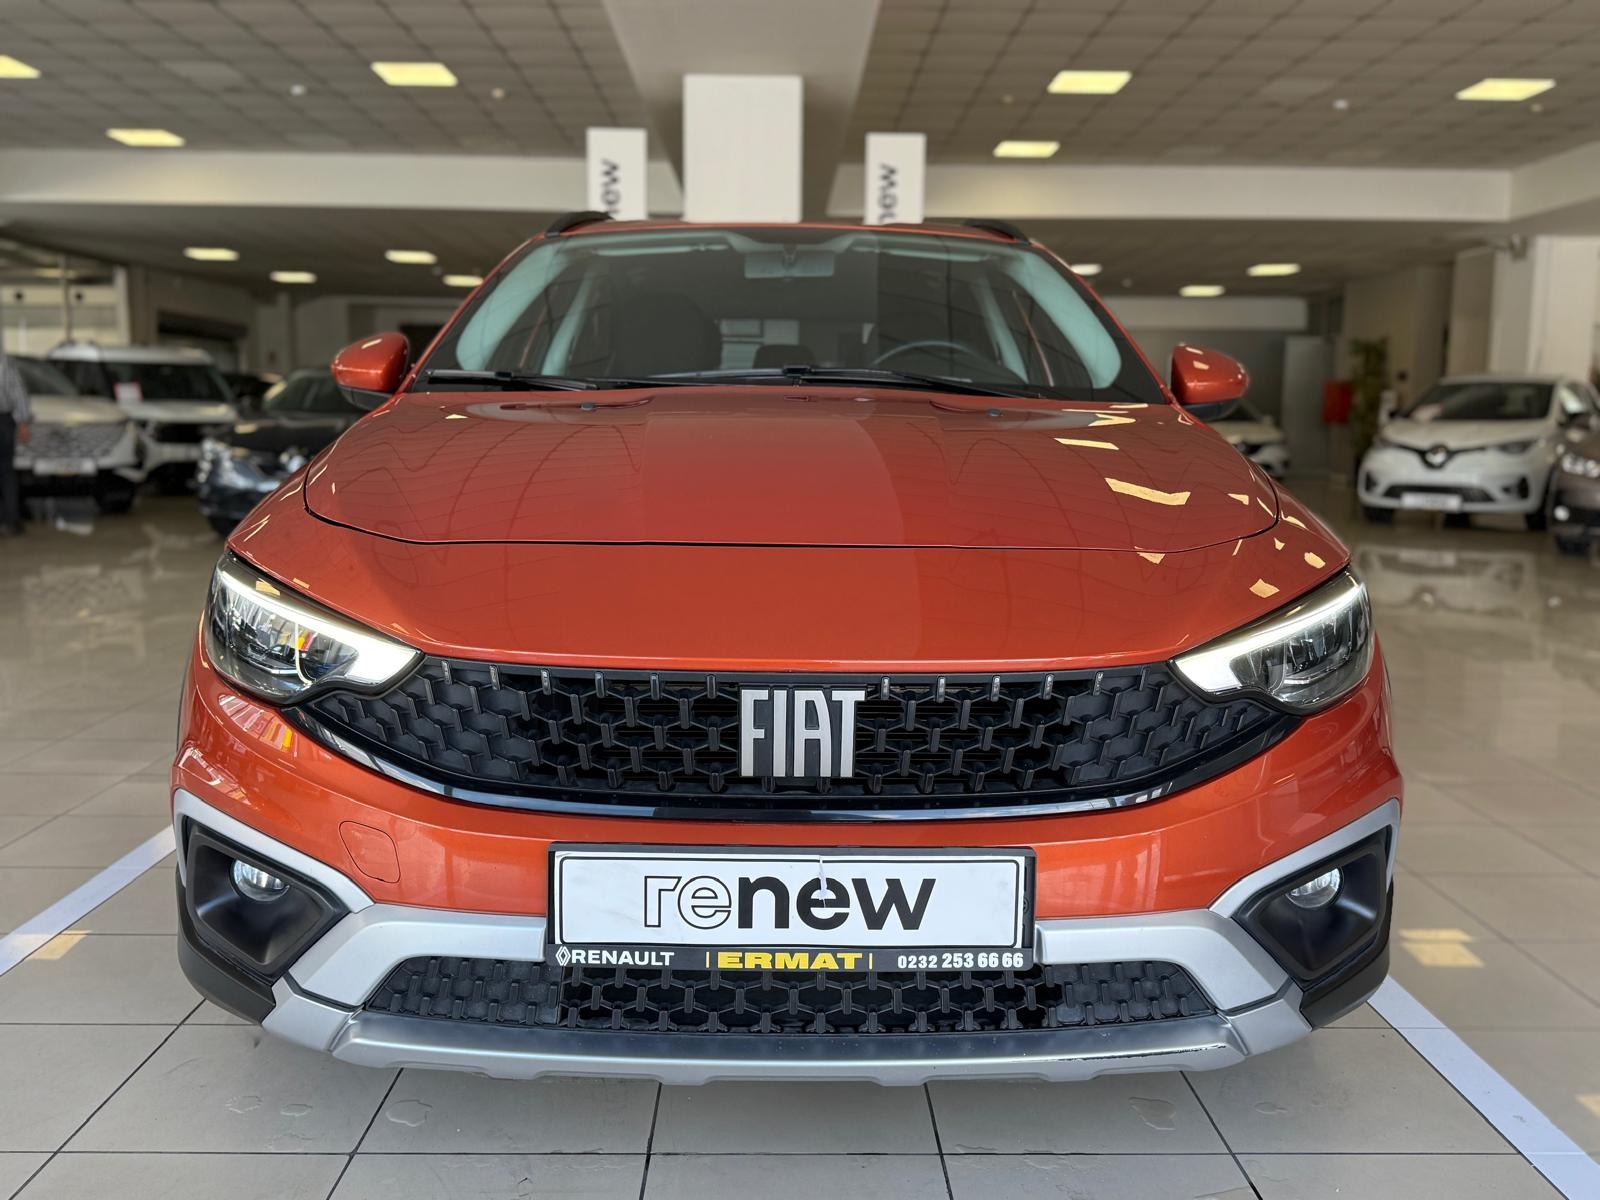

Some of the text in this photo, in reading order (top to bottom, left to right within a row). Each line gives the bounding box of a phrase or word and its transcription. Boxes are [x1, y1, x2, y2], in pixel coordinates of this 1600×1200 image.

[740, 689, 866, 778] FIAT
[643, 875, 936, 931] renew
[571, 950, 675, 967] RENAULT
[717, 952, 862, 970] ERMAT
[897, 952, 1024, 969] 0232 253 66 66
